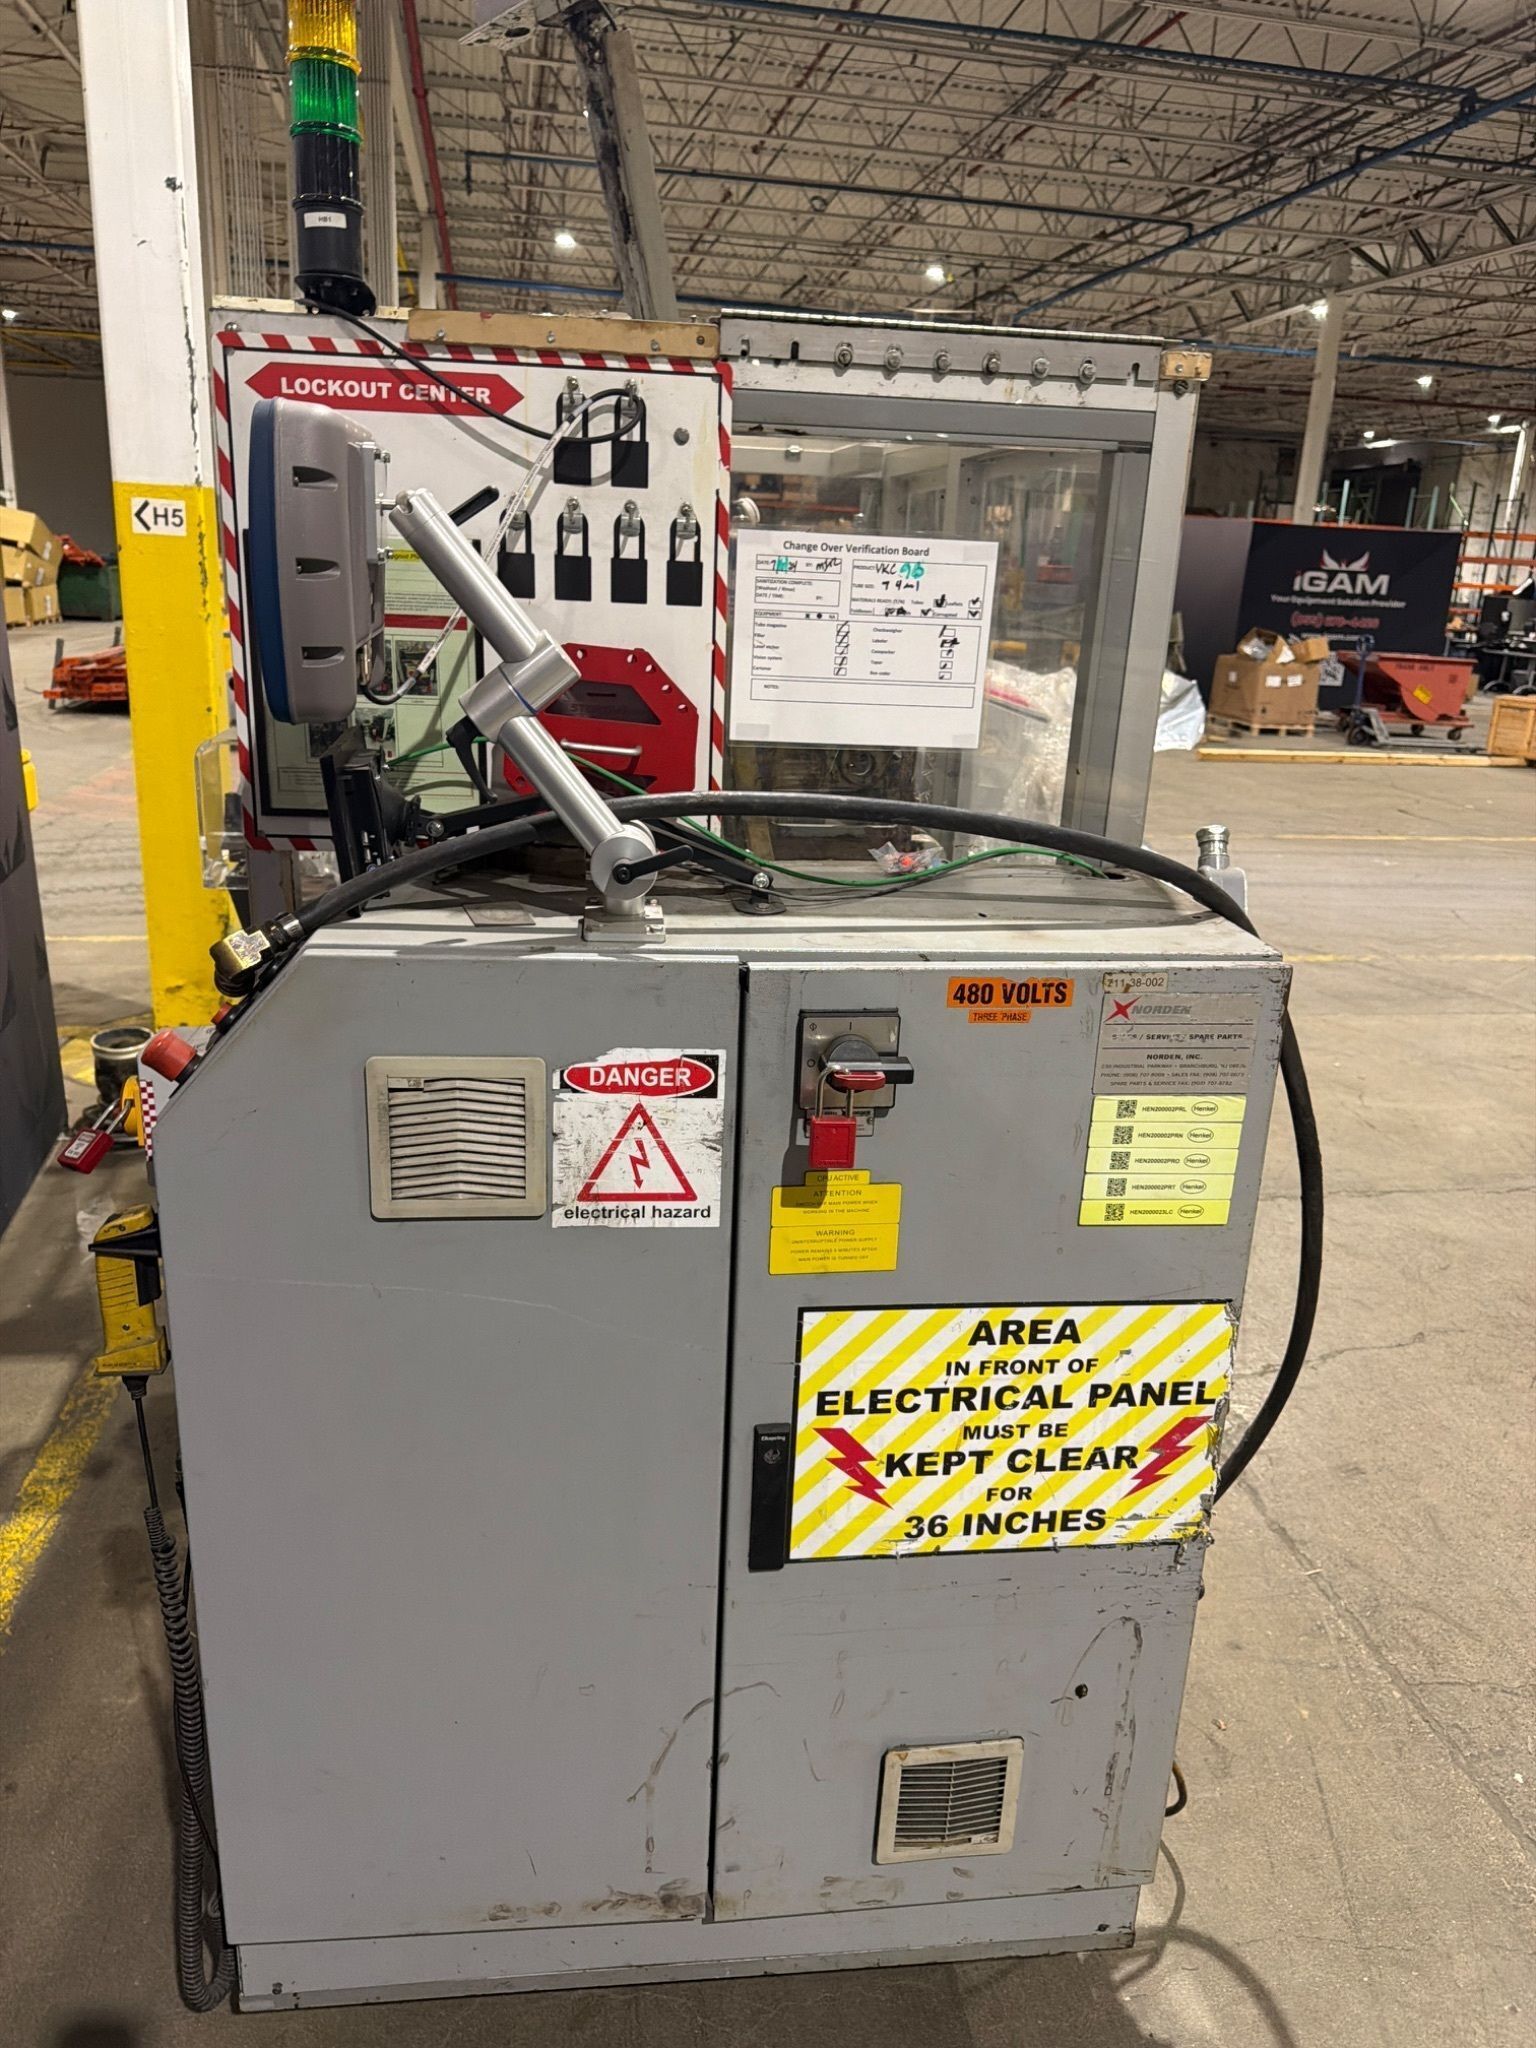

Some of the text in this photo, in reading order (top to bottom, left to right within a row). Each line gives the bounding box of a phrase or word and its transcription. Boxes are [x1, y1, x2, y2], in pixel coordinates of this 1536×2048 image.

[280, 376, 492, 404] LOCKOUT CENTER
[152, 506, 184, 528] H5
[783, 540, 930, 556] Change Over Verification Board
[1292, 570, 1390, 596] iGAM
[952, 982, 1068, 1004] 480 VOLTS
[972, 1012, 1028, 1021] THREE PHASE
[1132, 1005, 1192, 1015] NORDEN
[589, 1067, 692, 1087] DANGER
[564, 1205, 712, 1219] electrical hazard
[968, 1318, 1082, 1346] AREA
[945, 1358, 1099, 1376] IN FRONT OF
[816, 1380, 1217, 1416] ELECTRICAL PANEL
[962, 1423, 1068, 1441] MUST BE
[884, 1446, 1140, 1478] KEPT CLEAR
[986, 1486, 1032, 1502] FOR
[904, 1508, 1107, 1539] 36 INCHES
